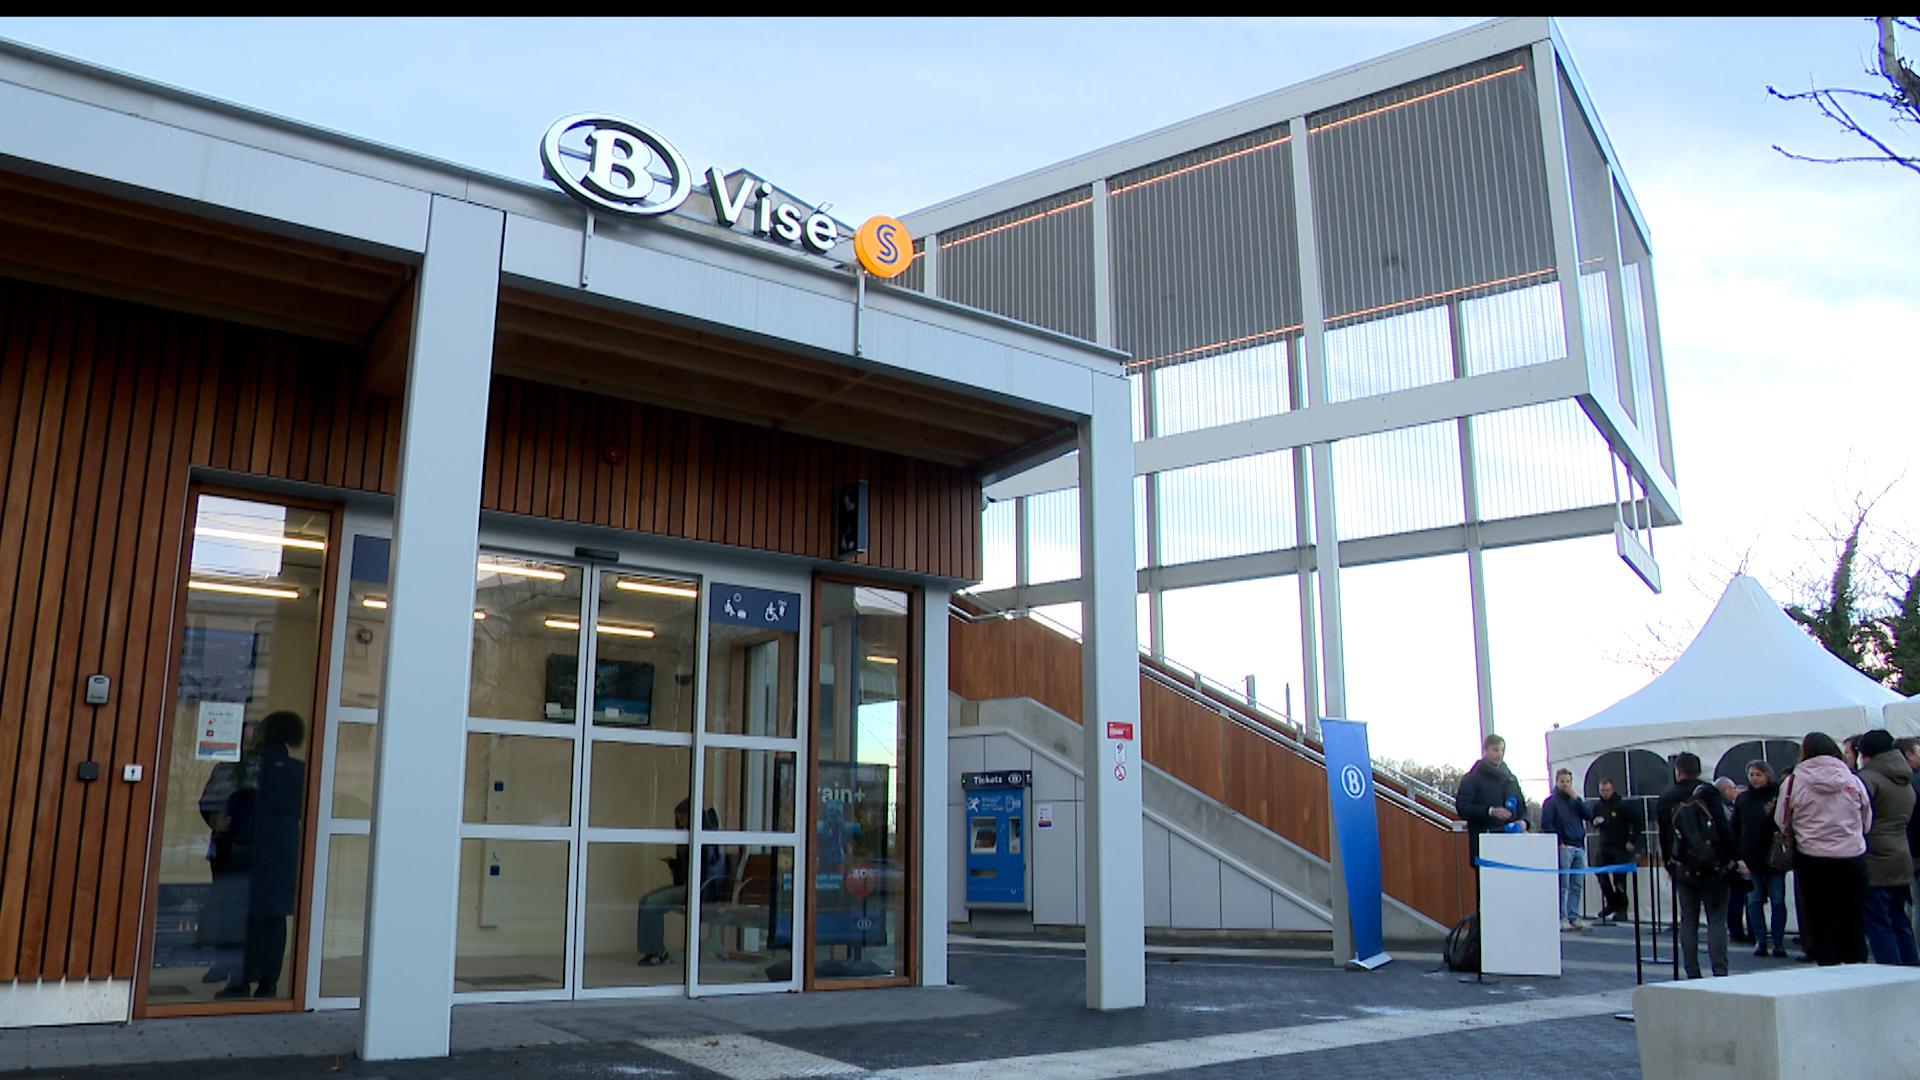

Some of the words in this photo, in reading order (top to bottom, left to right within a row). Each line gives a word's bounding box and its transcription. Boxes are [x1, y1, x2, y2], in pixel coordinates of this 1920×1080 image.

[705, 166, 840, 254] Visé
[973, 774, 1003, 785] Tickets
[817, 782, 866, 803] ain+
